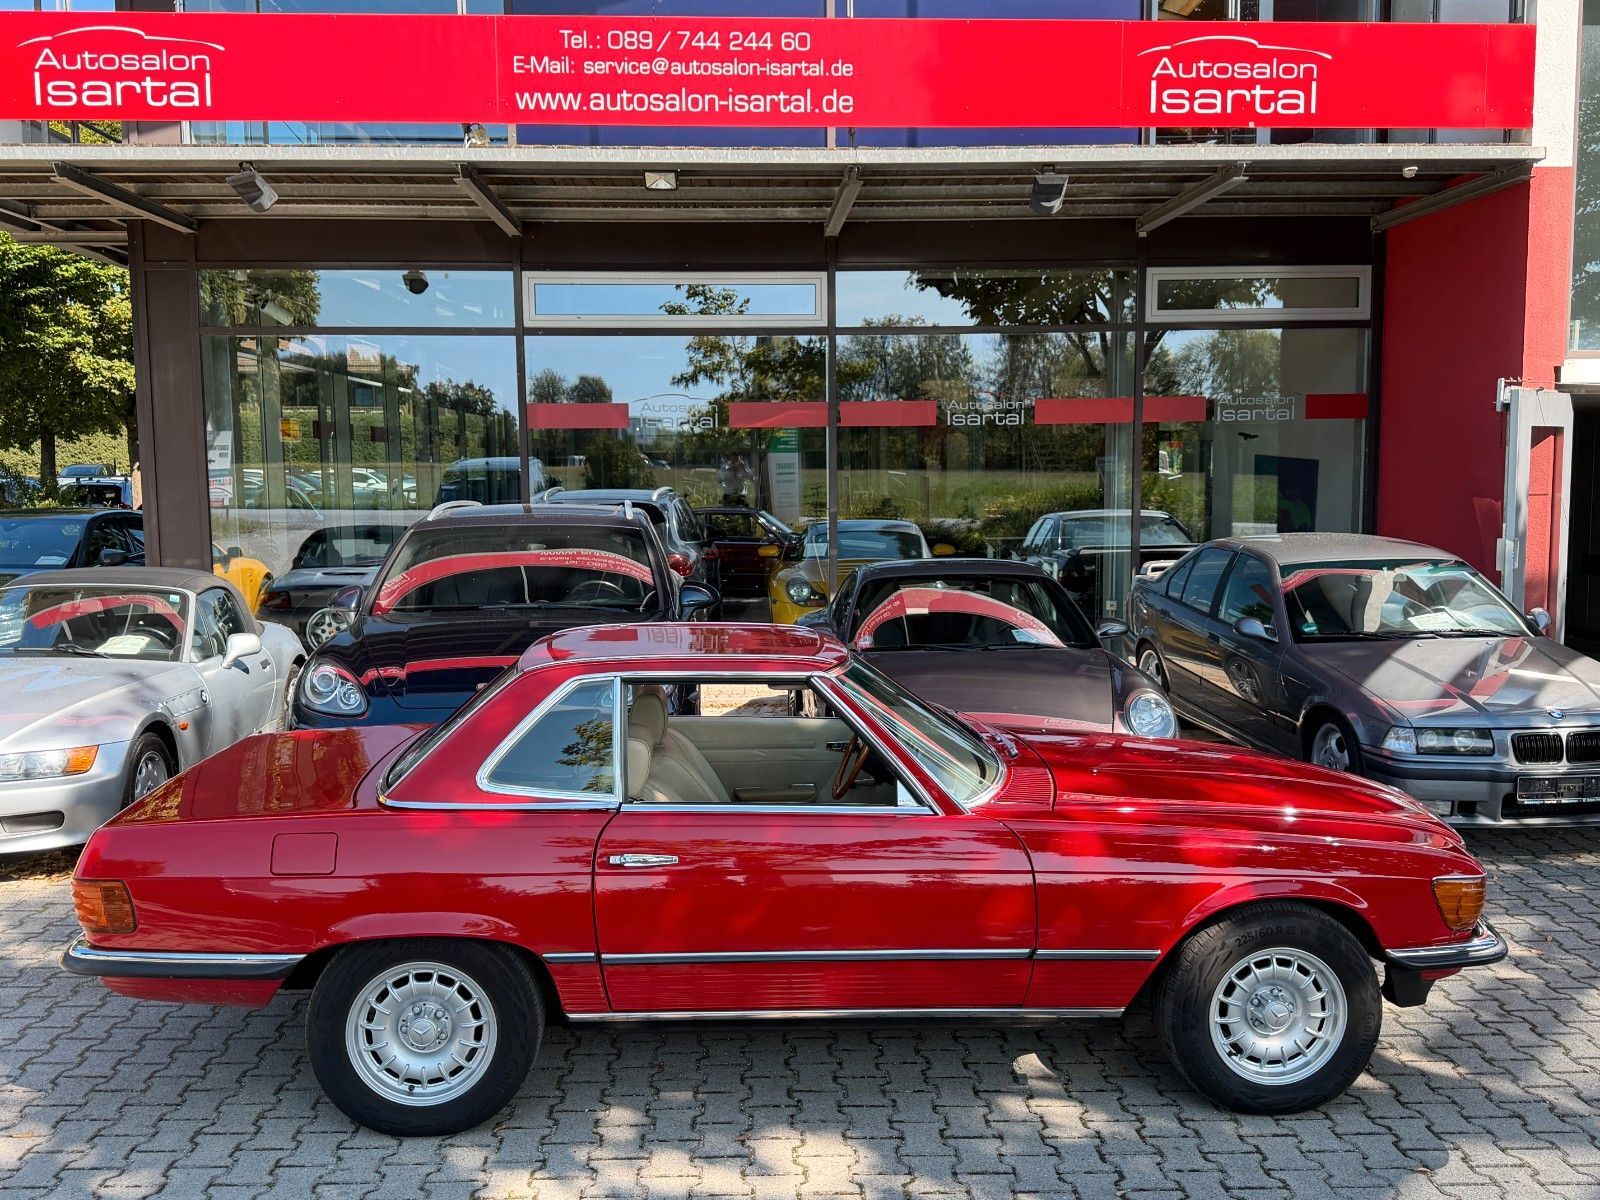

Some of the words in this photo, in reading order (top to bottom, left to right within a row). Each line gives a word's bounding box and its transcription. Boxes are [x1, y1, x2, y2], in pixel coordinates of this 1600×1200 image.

[559, 30, 600, 49] Tel.:
[608, 31, 653, 50] 089
[677, 31, 721, 51] 744
[729, 32, 773, 51] 244
[781, 32, 811, 51] 60
[34, 48, 211, 71] Autosalon
[513, 56, 575, 74] E-Mail:
[583, 58, 854, 77] service@autosalon-isartal.de
[1152, 56, 1318, 79] Autosalon
[34, 72, 212, 107] Isartal
[1150, 79, 1317, 114] Isartal
[515, 88, 854, 114] www.autosalon-isartal.de
[947, 399, 1024, 410] Autosalon
[1218, 394, 1296, 405] Autosalon
[640, 411, 718, 428] Isartal
[947, 409, 1025, 426] Isartal
[1217, 405, 1295, 422] Isartal
[1235, 926, 1274, 948] 225/60
